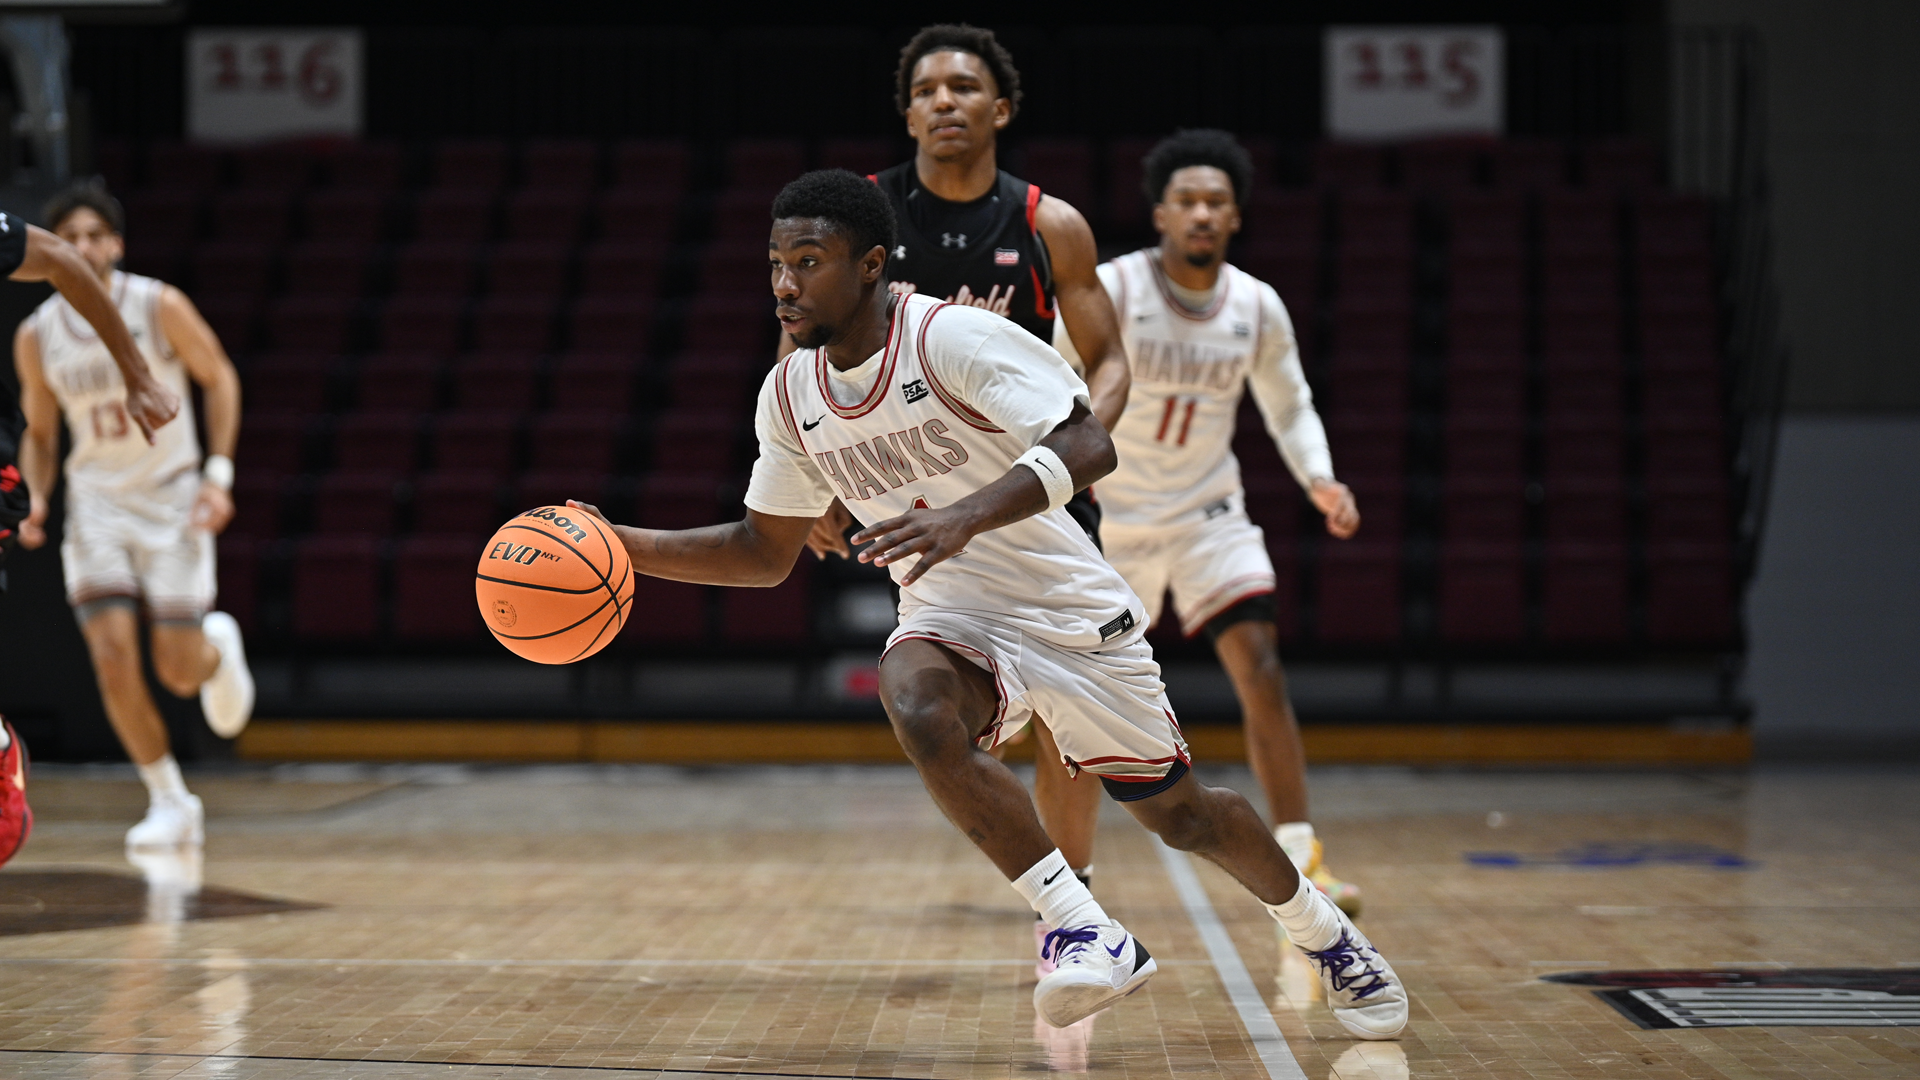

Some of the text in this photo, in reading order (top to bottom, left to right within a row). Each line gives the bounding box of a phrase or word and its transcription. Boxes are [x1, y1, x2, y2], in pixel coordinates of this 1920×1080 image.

[209, 41, 343, 107] 116
[1353, 41, 1480, 107] 115
[1134, 337, 1245, 390] HAWKS
[91, 401, 129, 439] 13
[1155, 396, 1196, 446] 11
[815, 418, 969, 500] HAWKS
[525, 507, 587, 543] ilson
[488, 541, 563, 565] EVO NXT
